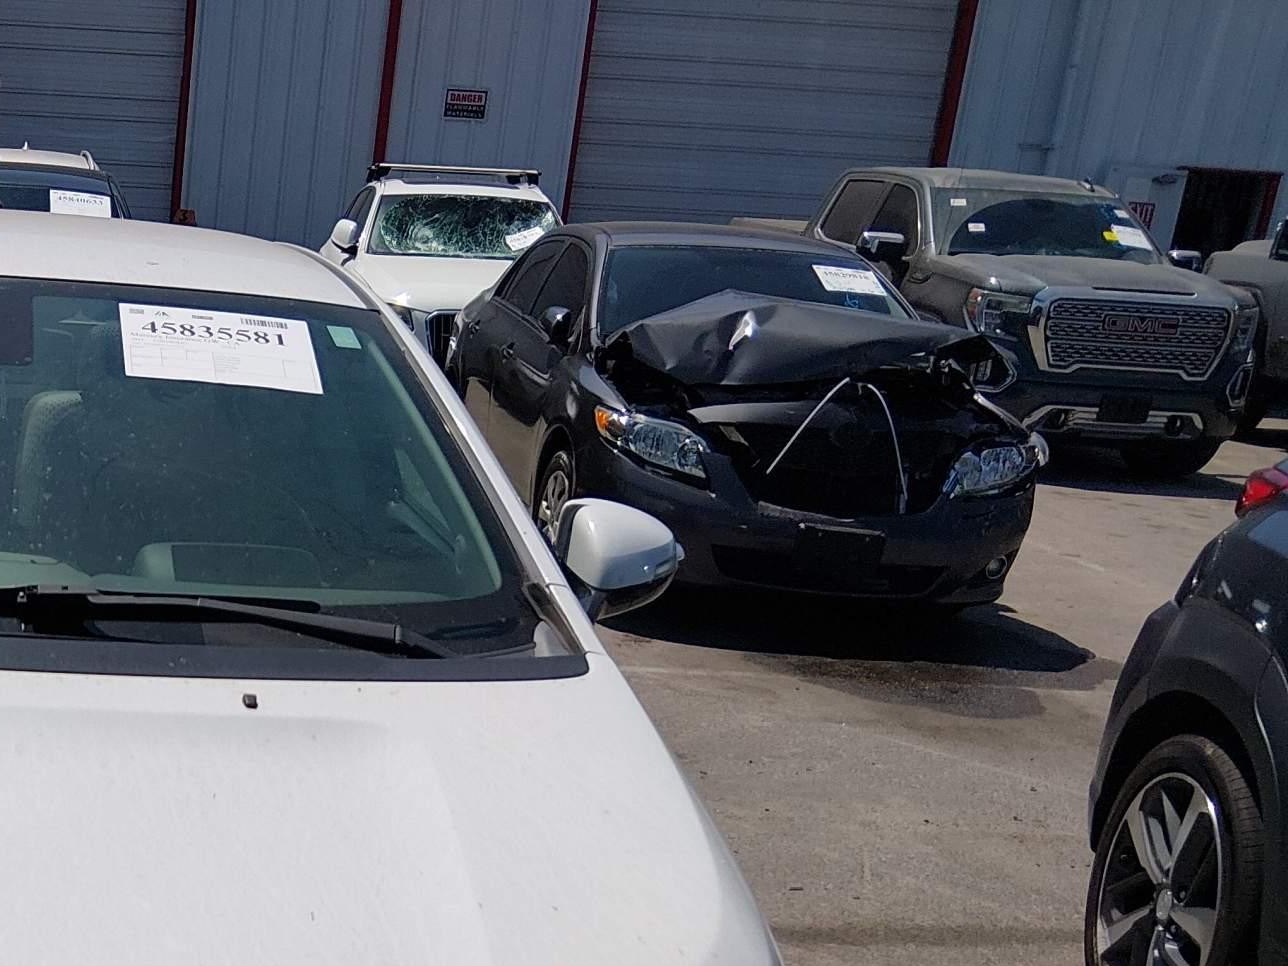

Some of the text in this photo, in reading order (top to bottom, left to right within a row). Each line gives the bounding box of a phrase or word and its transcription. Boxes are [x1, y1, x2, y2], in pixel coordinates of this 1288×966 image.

[450, 93, 483, 104] DANGER
[141, 320, 286, 347] 45835581
[1105, 316, 1178, 334] GMC
